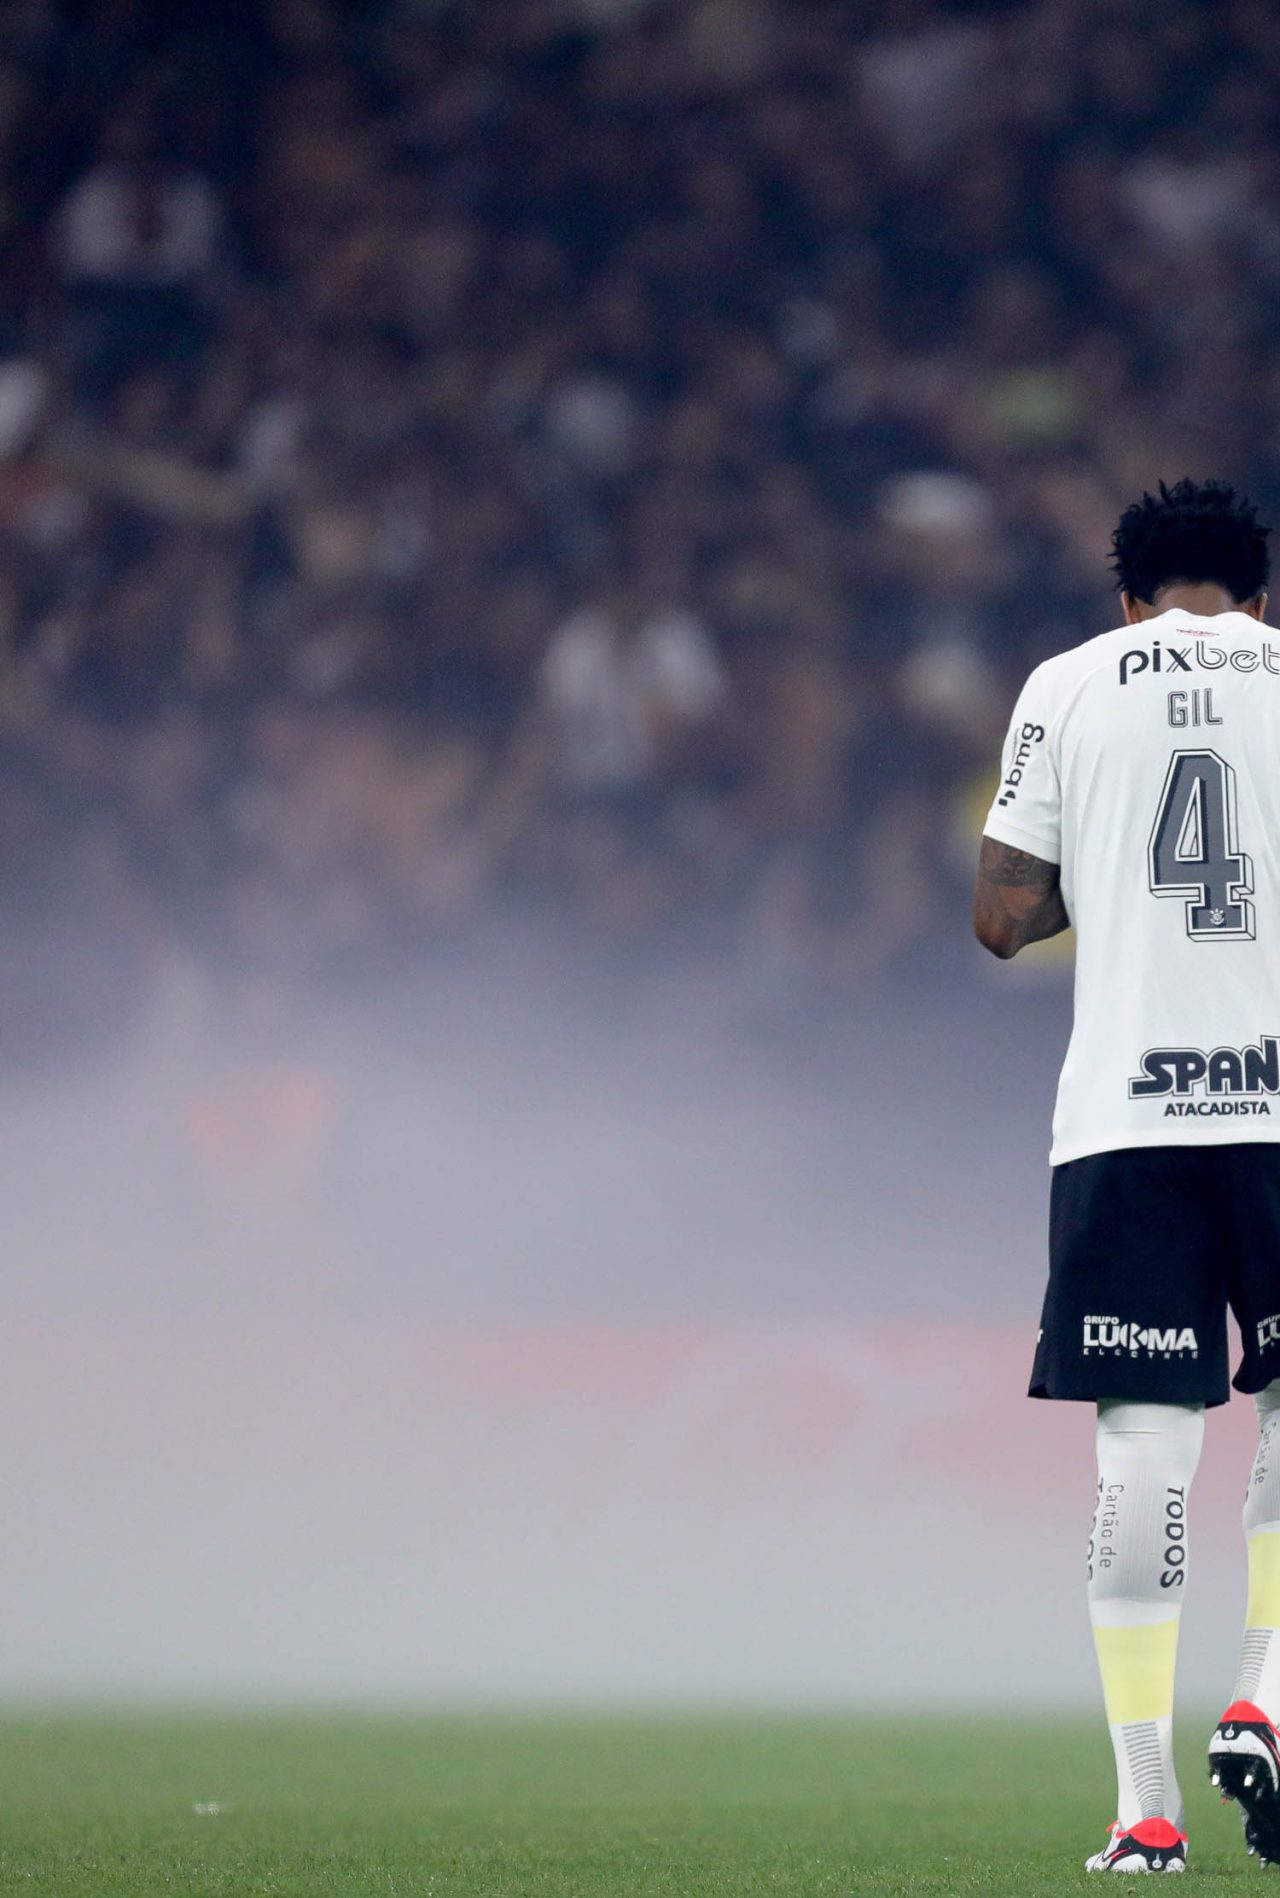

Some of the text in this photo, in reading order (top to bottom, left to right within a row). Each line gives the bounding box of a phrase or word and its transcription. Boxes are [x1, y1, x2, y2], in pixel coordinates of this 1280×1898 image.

[1119, 640, 1280, 685] pixbet
[1167, 687, 1223, 729] GIL
[1004, 722, 1045, 787] bmg
[1148, 748, 1256, 942] 4
[1164, 1101, 1271, 1117] ATACADISTA
[1083, 1315, 1120, 1325] GRUPO
[1099, 1484, 1125, 1568] Cartão de
[1160, 1486, 1185, 1589] TODOS
